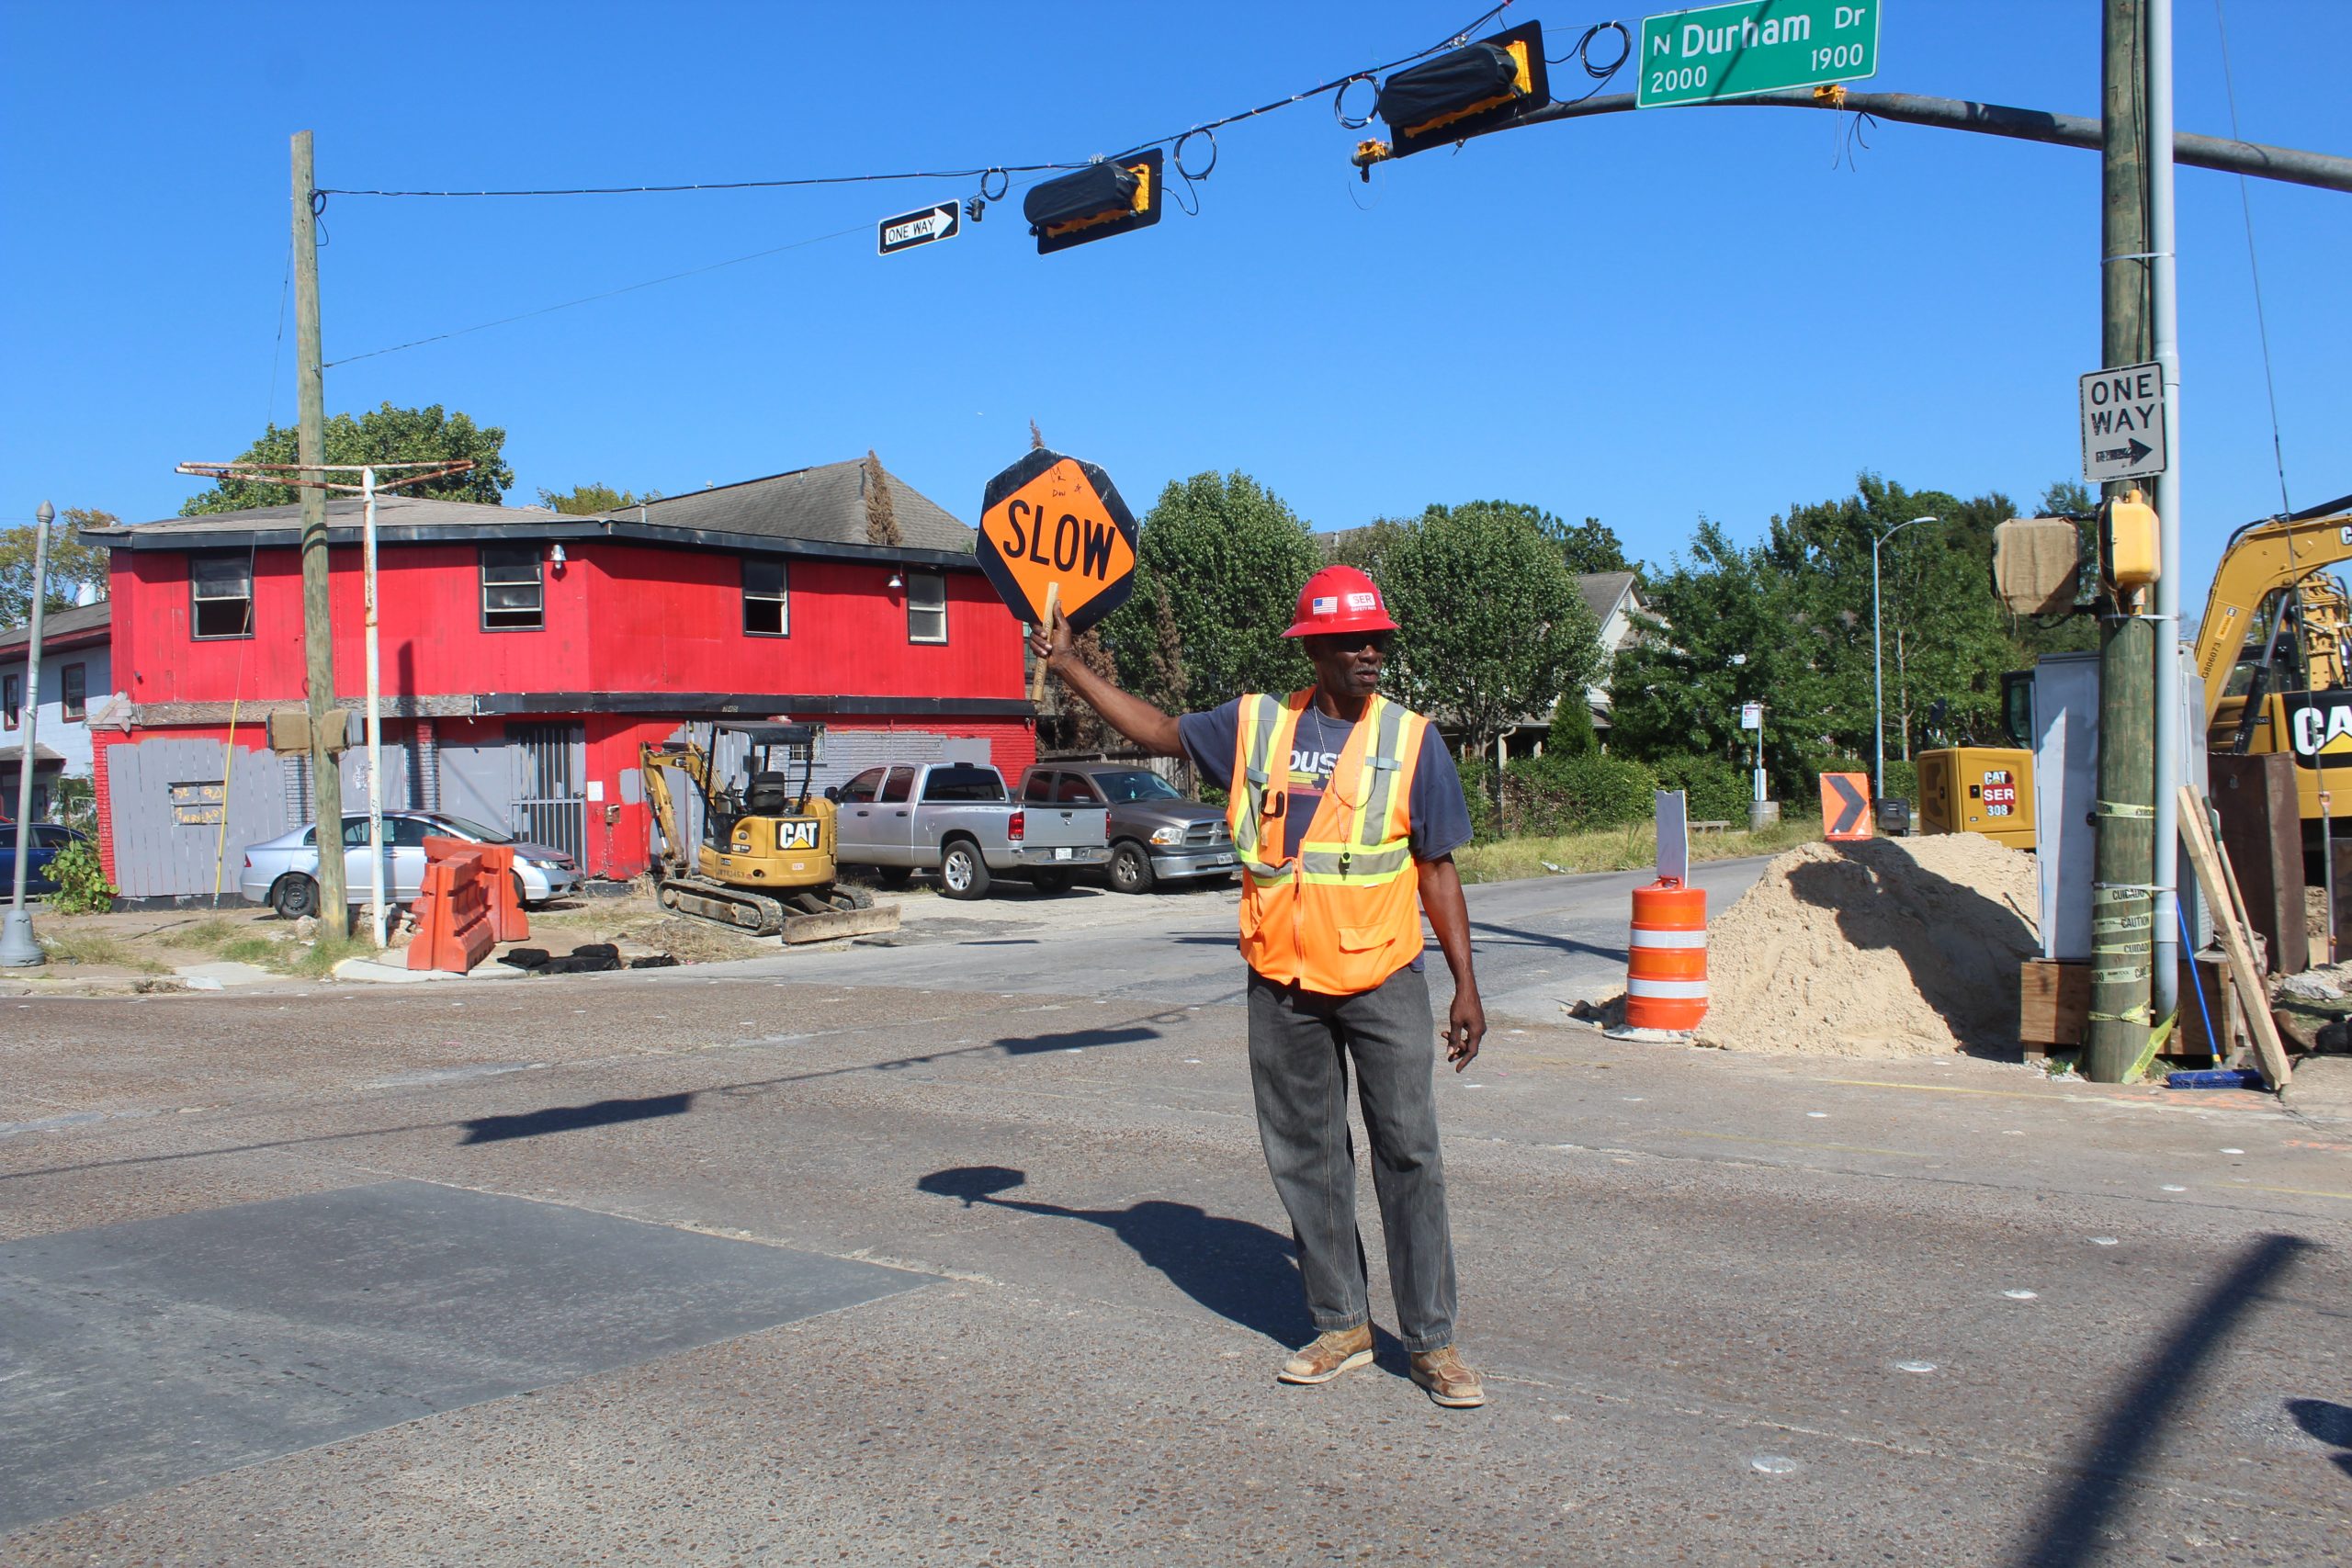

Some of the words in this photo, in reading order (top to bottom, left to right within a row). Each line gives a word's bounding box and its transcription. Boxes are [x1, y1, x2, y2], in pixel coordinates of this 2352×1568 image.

[1654, 35, 1670, 56] N
[1681, 15, 1810, 58] Durham
[1835, 6, 1866, 29] Dr
[1811, 43, 1863, 71] 1900
[1651, 65, 1707, 93] 2000
[888, 225, 909, 242] ONE
[913, 219, 934, 235] WAY
[2091, 373, 2154, 405] ONE
[2090, 404, 2154, 435] WAY
[1003, 500, 1115, 581] SLOW
[1352, 595, 1372, 604] SER
[2202, 642, 2222, 683] G806073
[1288, 750, 1341, 774] ous
[1984, 771, 2007, 784] CAT
[1984, 788, 2014, 801] SER
[1987, 804, 2007, 816] 308
[780, 822, 818, 849] CAT
